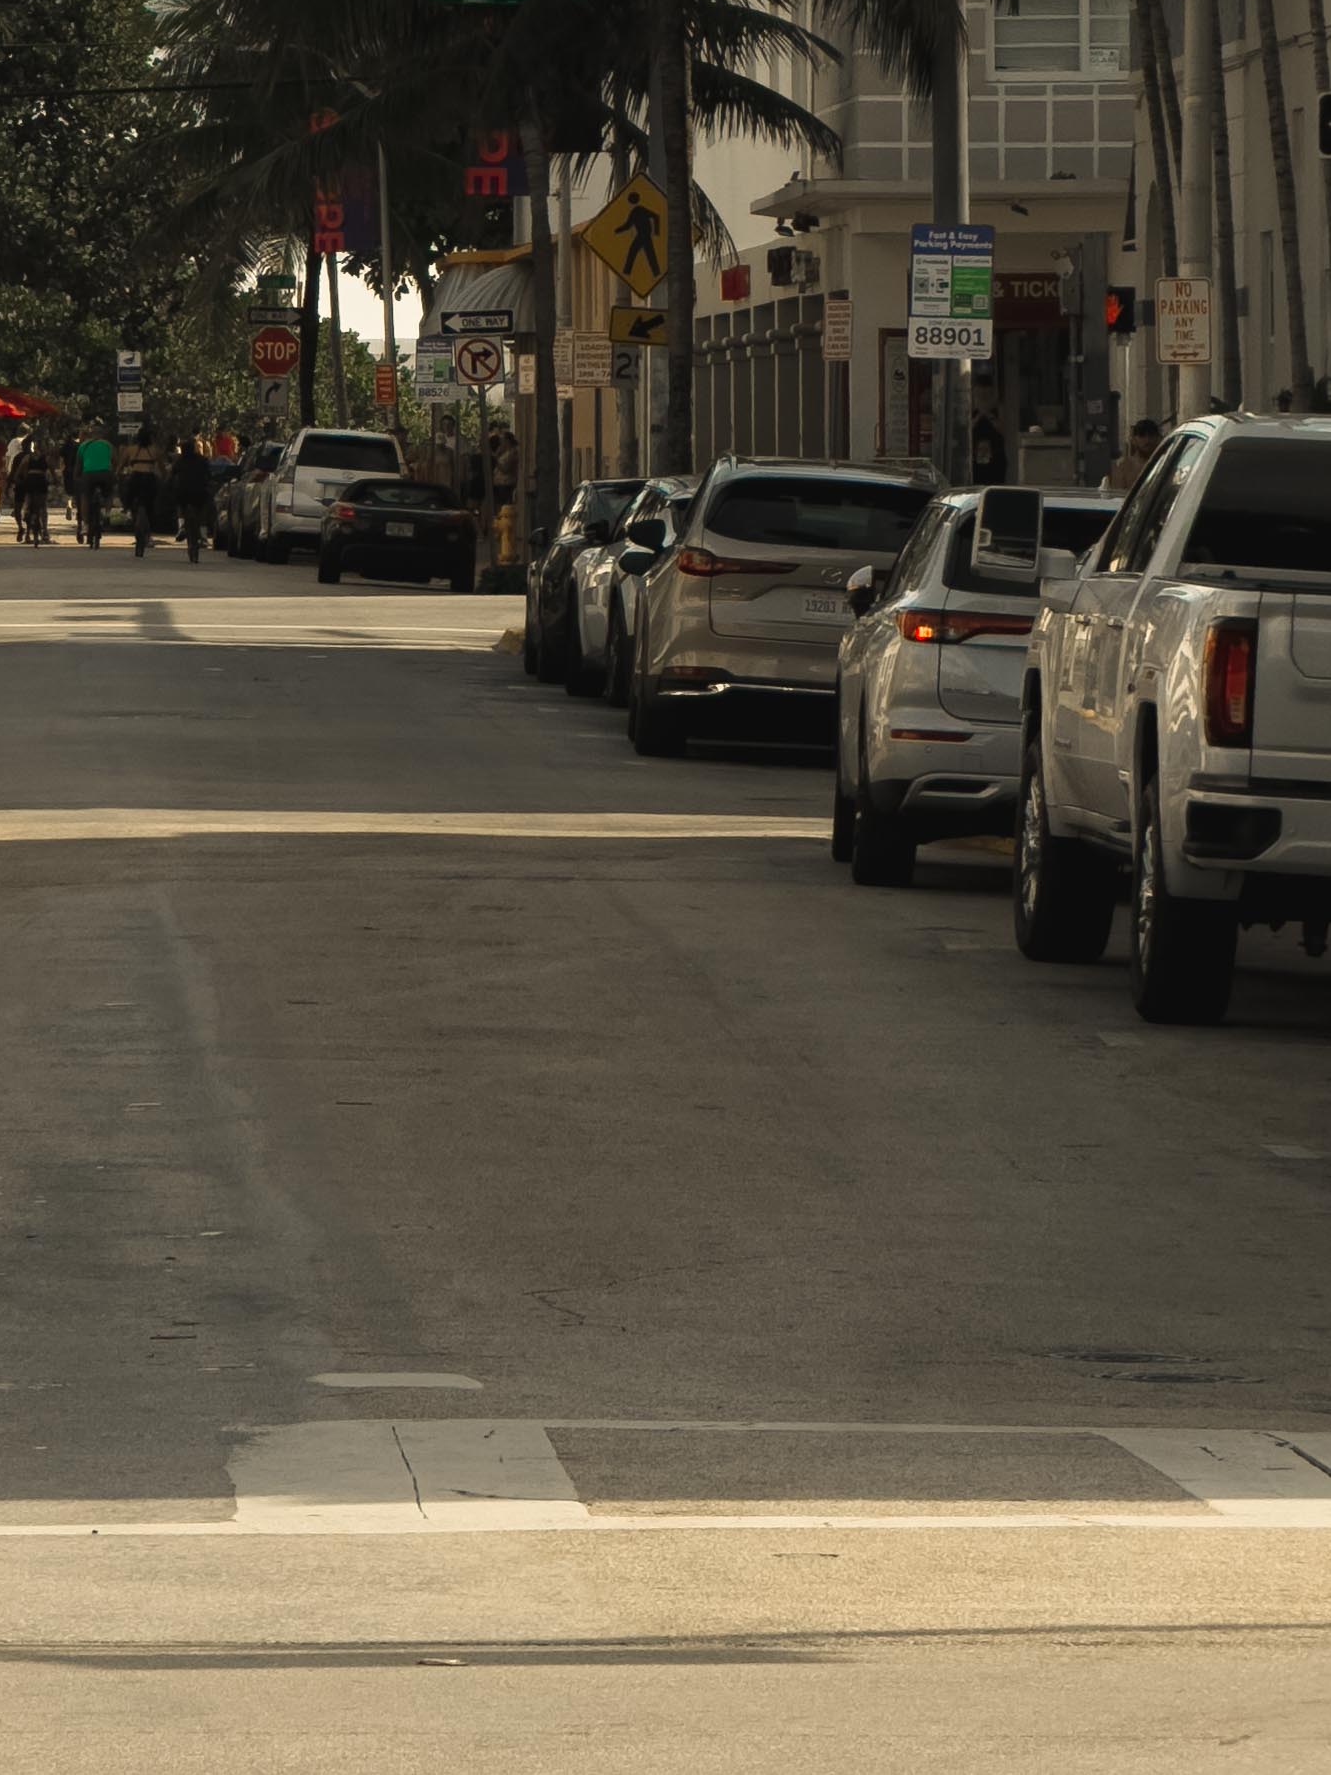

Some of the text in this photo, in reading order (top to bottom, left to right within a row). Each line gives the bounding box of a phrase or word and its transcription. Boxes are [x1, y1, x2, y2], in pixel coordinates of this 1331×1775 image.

[928, 231, 979, 242] Fast & Easy
[914, 239, 993, 250] Parking Payments
[992, 280, 1060, 298] & TICK
[1175, 282, 1192, 297] NO
[1160, 299, 1207, 314] PARKING
[462, 317, 505, 327] ONE WAY
[1174, 318, 1194, 328] ANY
[915, 326, 985, 346] 88901
[1175, 330, 1195, 340] TIME
[254, 341, 297, 361] STOP
